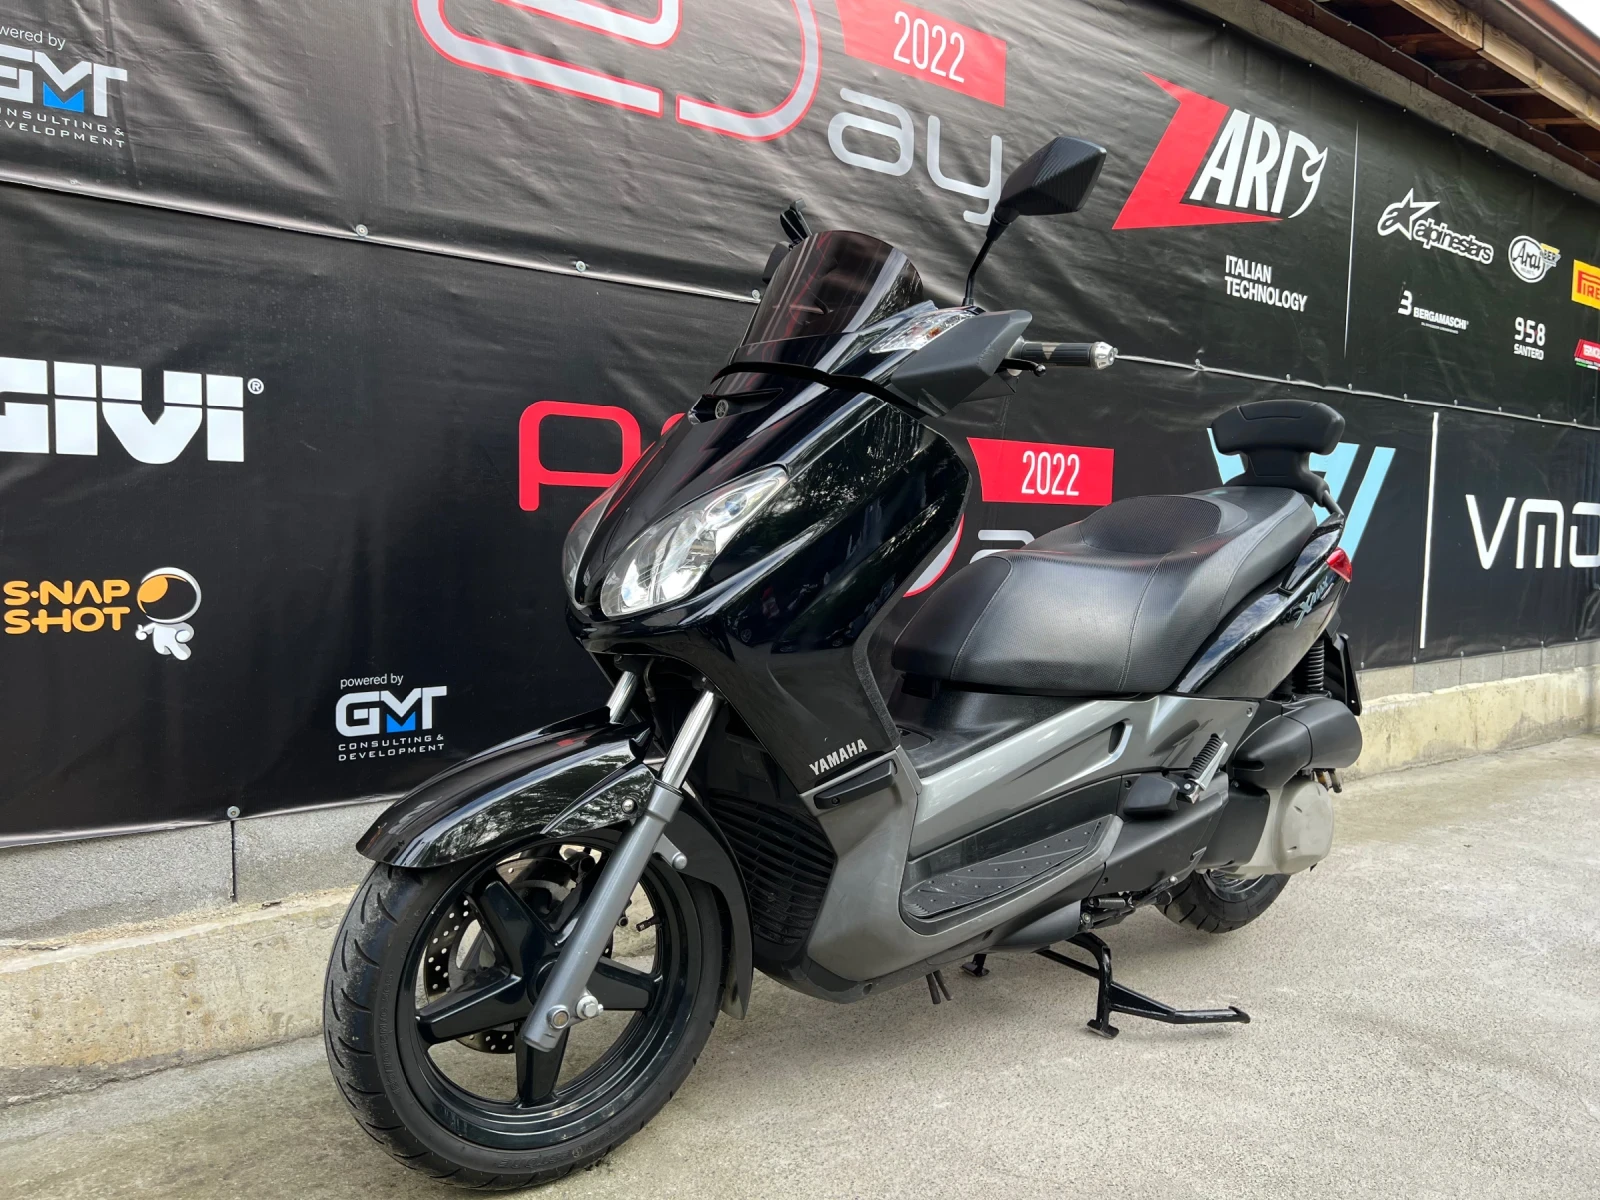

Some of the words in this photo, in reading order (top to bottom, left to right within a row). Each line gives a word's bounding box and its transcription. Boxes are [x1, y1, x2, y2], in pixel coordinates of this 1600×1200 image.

[48, 32, 66, 50] by
[893, 11, 965, 83] 2022
[0, 107, 107, 133] NSULTING
[114, 127, 125, 136] &
[0, 119, 125, 148] VELOPMENT
[1413, 217, 1494, 265] alpinestars
[1225, 255, 1272, 284] ITALIAN
[1225, 276, 1308, 312] TECHNOLOGY
[1514, 316, 1546, 346] 958
[1513, 343, 1545, 361] SANTERO
[1021, 450, 1081, 496] 2022
[3, 606, 131, 635] SHOT
[340, 673, 387, 689] powered
[390, 672, 404, 686] by
[335, 685, 448, 737] GMT
[338, 735, 432, 751] CONSULTING
[436, 733, 444, 741] &
[338, 743, 445, 762] DEVELOPMENT
[808, 738, 868, 776] YAMAHA
